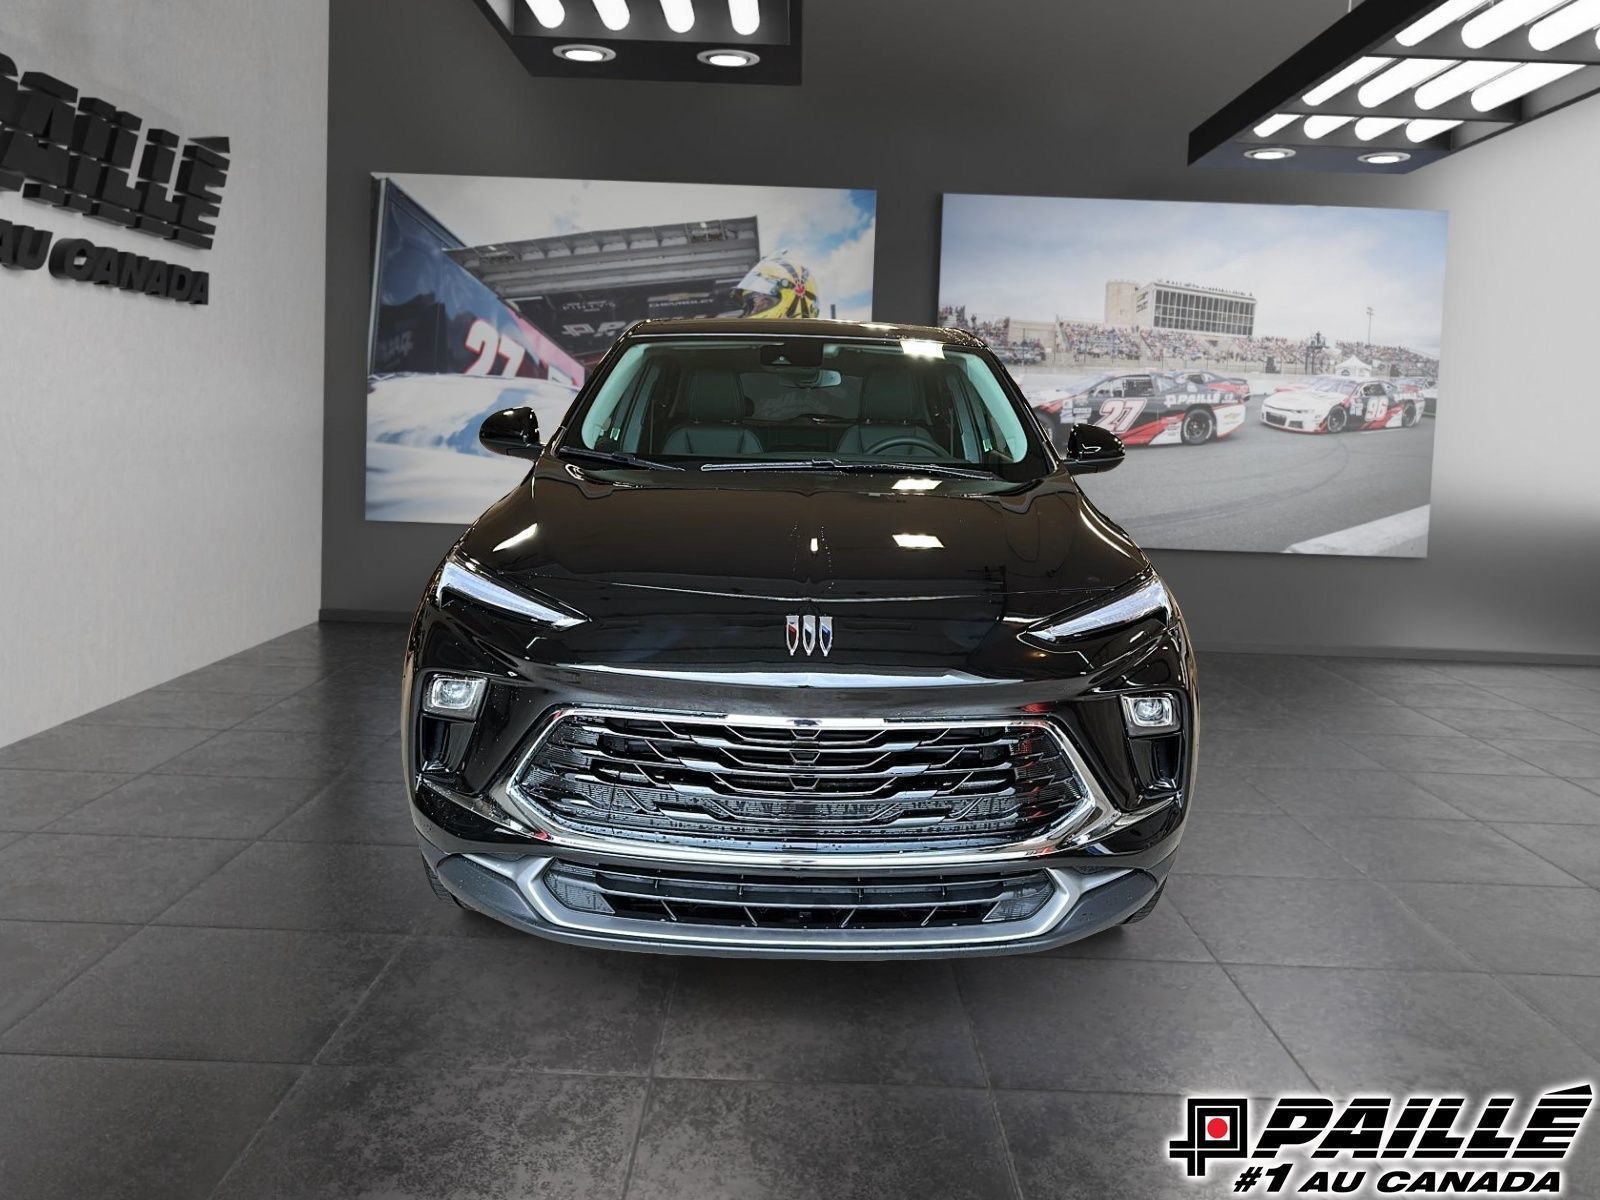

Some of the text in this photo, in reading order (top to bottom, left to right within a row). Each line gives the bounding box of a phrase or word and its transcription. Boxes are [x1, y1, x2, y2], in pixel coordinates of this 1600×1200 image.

[0, 53, 231, 250] AILLÉ
[48, 238, 209, 305] CANADA
[464, 318, 526, 377] 27
[1093, 397, 1148, 434] 27
